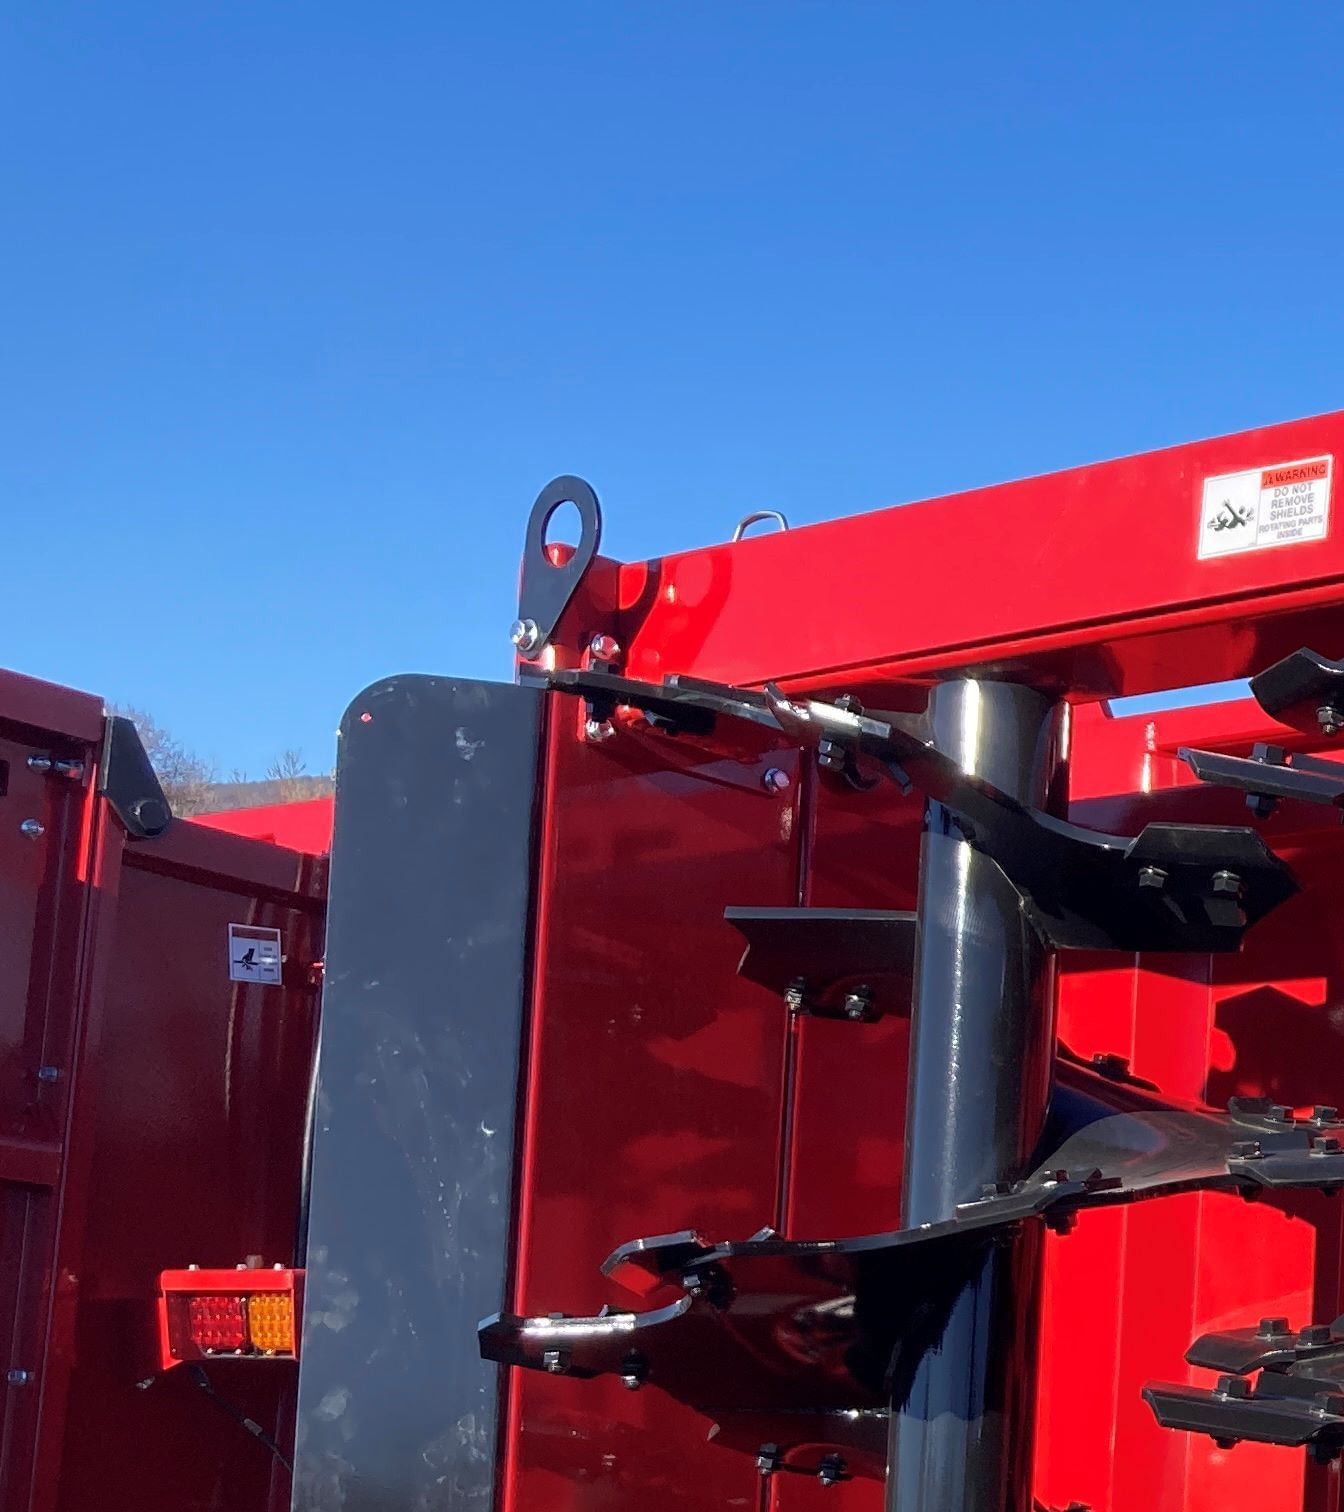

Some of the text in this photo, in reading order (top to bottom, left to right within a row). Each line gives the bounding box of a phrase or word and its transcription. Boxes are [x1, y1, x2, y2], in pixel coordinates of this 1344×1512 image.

[1275, 464, 1326, 482] WARNING
[1274, 482, 1313, 498] DO NOT
[1271, 493, 1315, 509] REMOVE
[1270, 504, 1314, 521] SHIELDS
[1259, 515, 1323, 533] ROTATING PARTS
[1277, 528, 1302, 539] INSIDE
